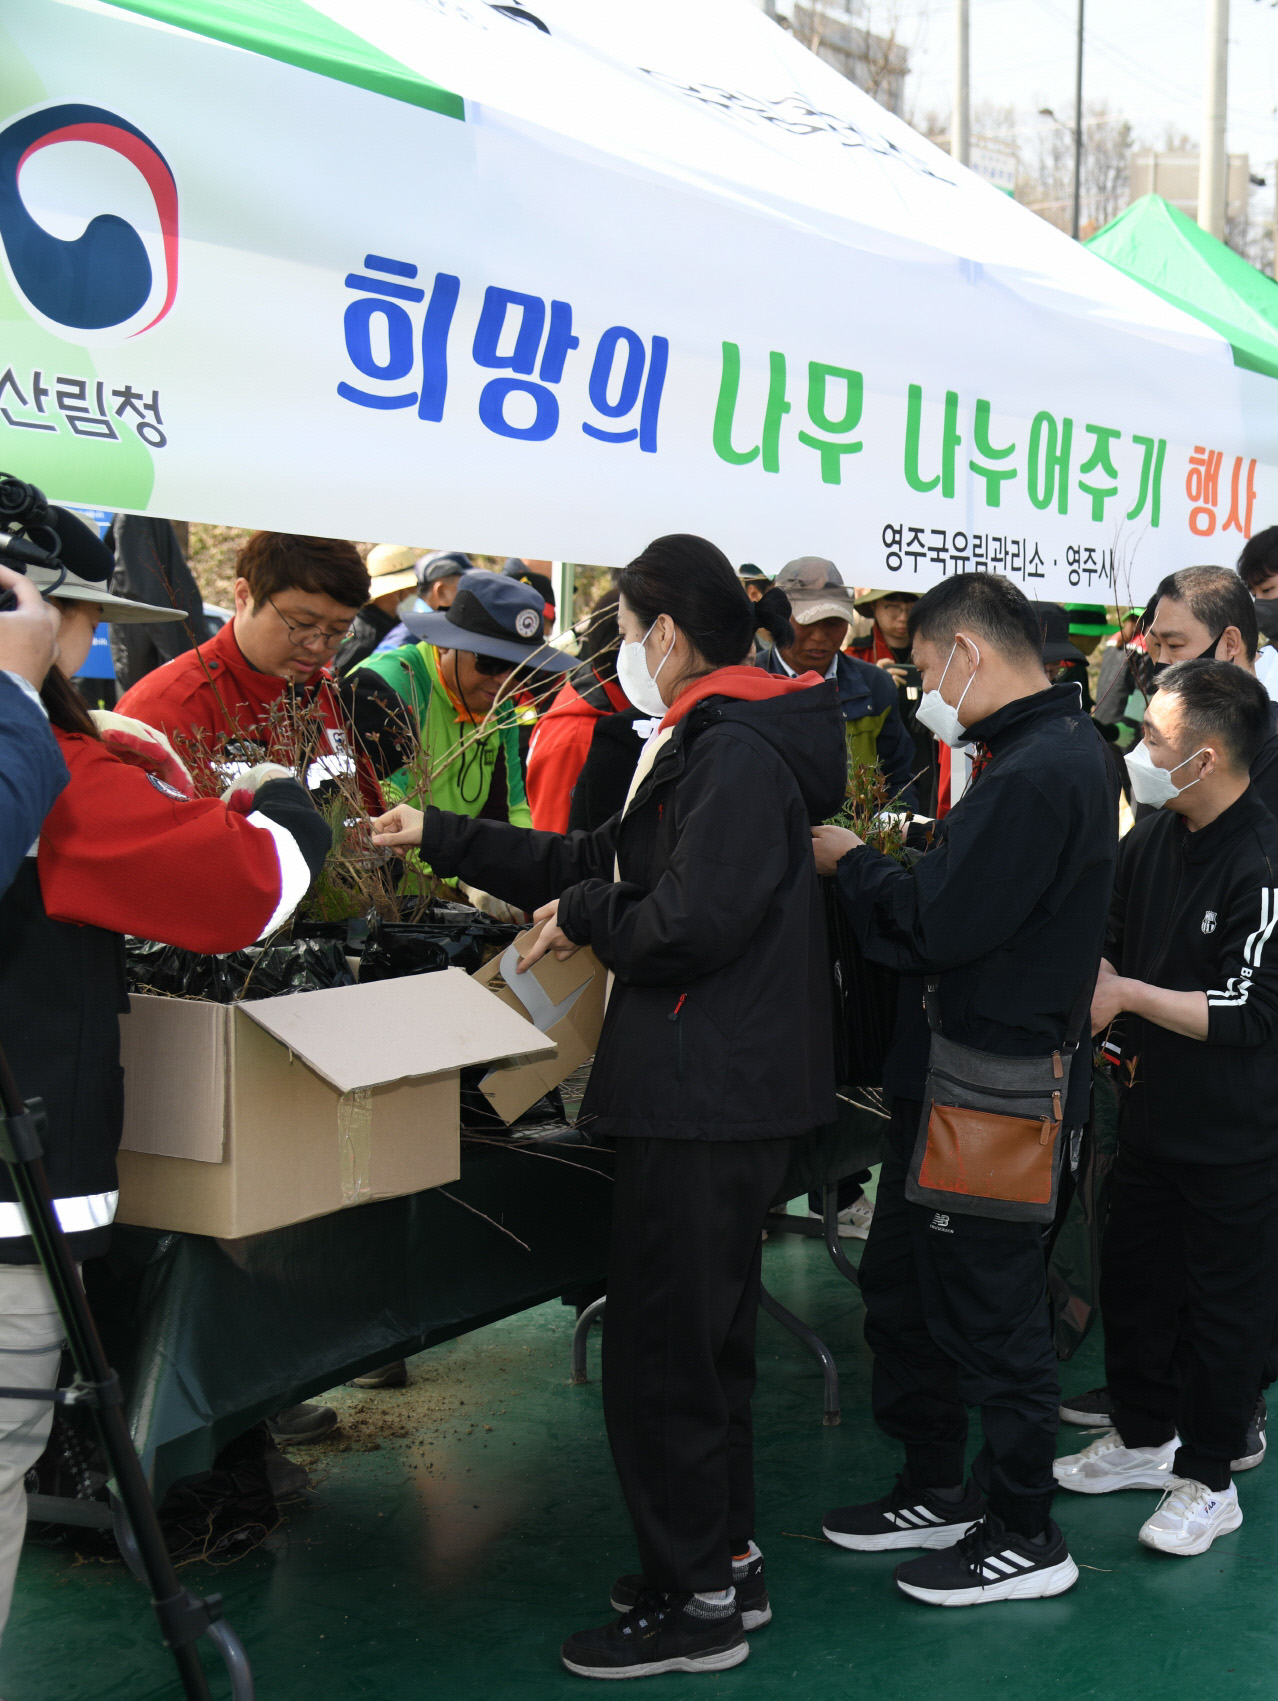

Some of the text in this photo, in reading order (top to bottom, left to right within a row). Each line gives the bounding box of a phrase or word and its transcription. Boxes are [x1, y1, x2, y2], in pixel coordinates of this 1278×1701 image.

[0, 367, 168, 449] 산림청
[337, 253, 1258, 540] 희망의 나무 나누어주기 행사
[882, 522, 1114, 589] 영주국유림관리소 영주시
